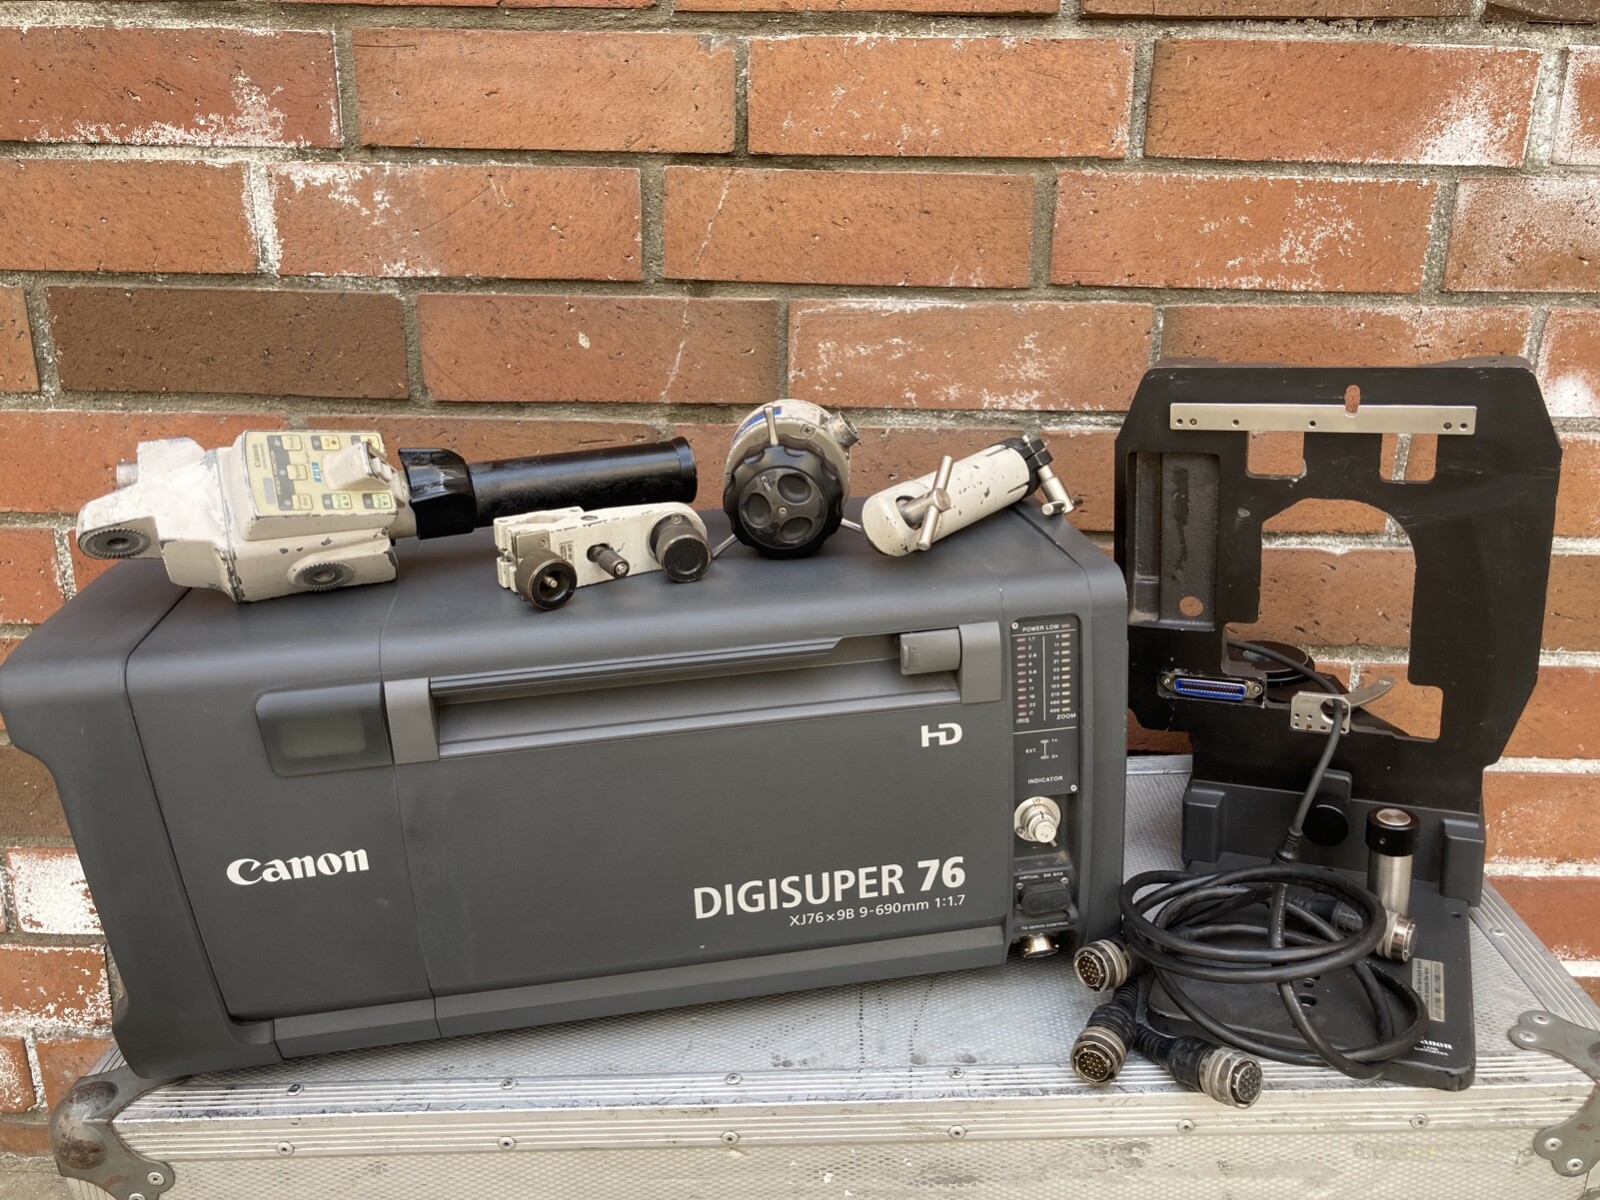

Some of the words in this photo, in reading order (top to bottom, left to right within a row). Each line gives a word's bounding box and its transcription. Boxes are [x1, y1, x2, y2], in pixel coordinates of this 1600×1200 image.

[921, 722, 963, 747] HD
[1028, 775, 1063, 784] INDICATOR
[226, 848, 370, 886] Canon
[693, 863, 905, 920] DIGISUPER
[917, 856, 966, 892] 76
[859, 899, 929, 918] 9-690mm
[934, 894, 966, 909] 1:1.7
[1420, 1039, 1453, 1050] anon
